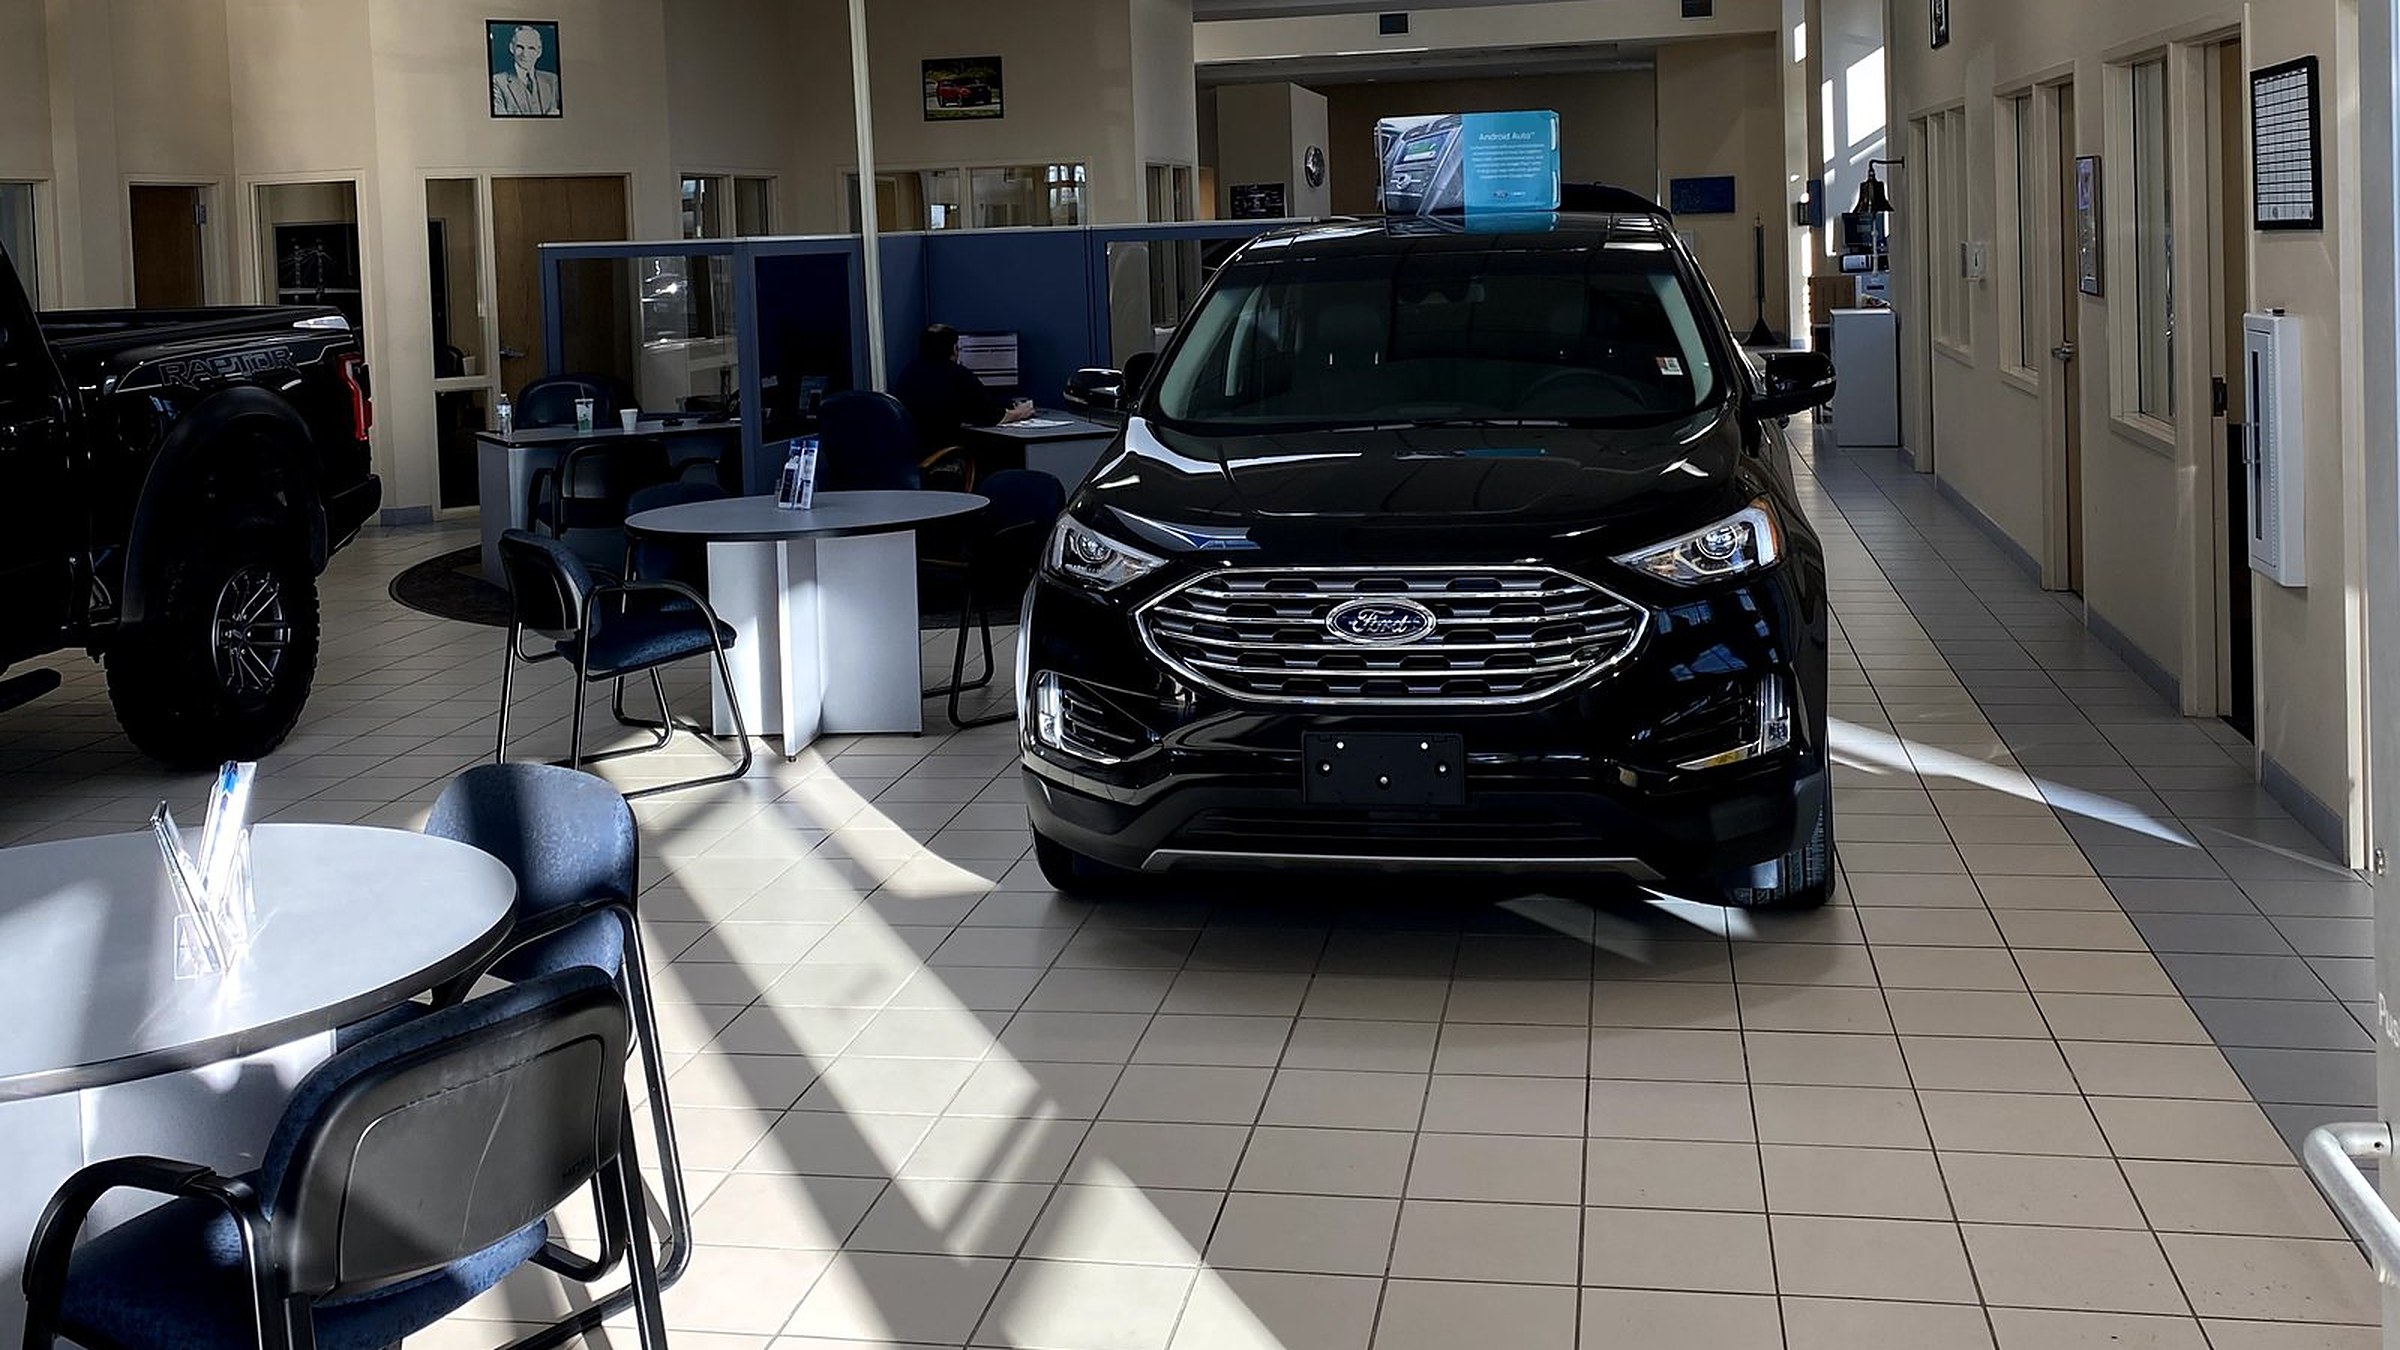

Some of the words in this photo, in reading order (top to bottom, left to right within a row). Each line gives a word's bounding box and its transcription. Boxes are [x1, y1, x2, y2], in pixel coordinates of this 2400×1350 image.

[1478, 132, 1510, 141] Android
[158, 346, 302, 390] RAPTOR
[1350, 608, 1420, 634] Ford
